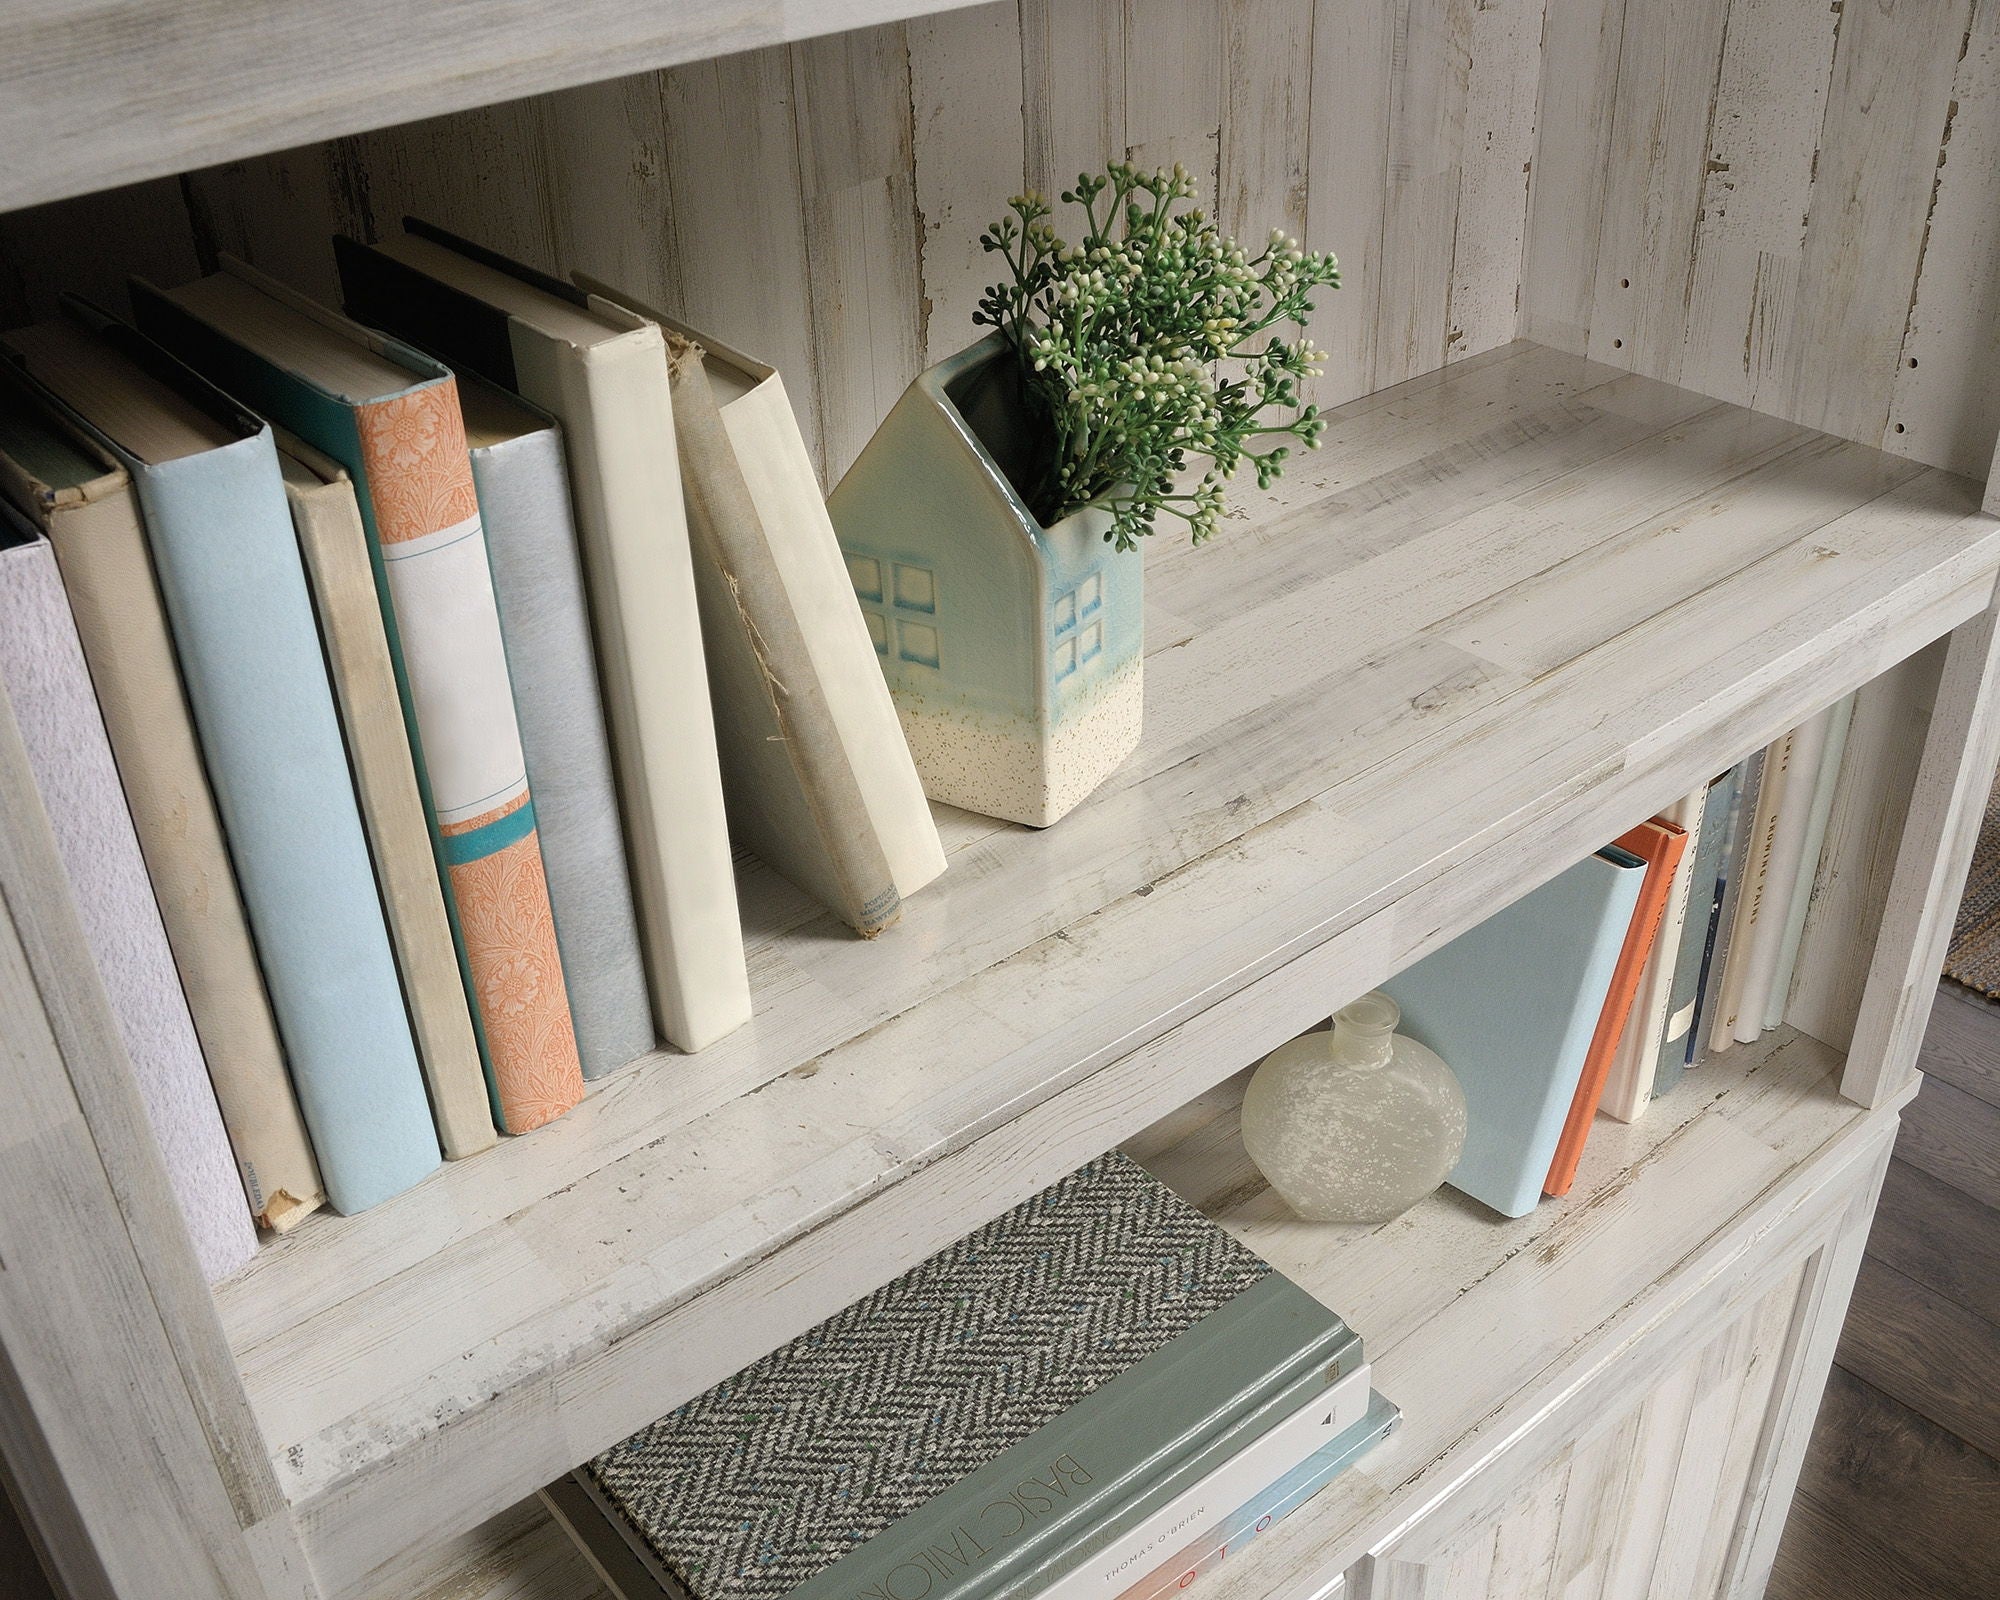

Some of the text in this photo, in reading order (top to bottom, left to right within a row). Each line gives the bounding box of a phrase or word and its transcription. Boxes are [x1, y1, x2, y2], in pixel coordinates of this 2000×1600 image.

[1750, 815, 1777, 924] GROWING PAINS
[856, 1453, 1093, 1600] BASIC TAILOR
[1104, 1506, 1205, 1581] THOMAS O'BRIEN
